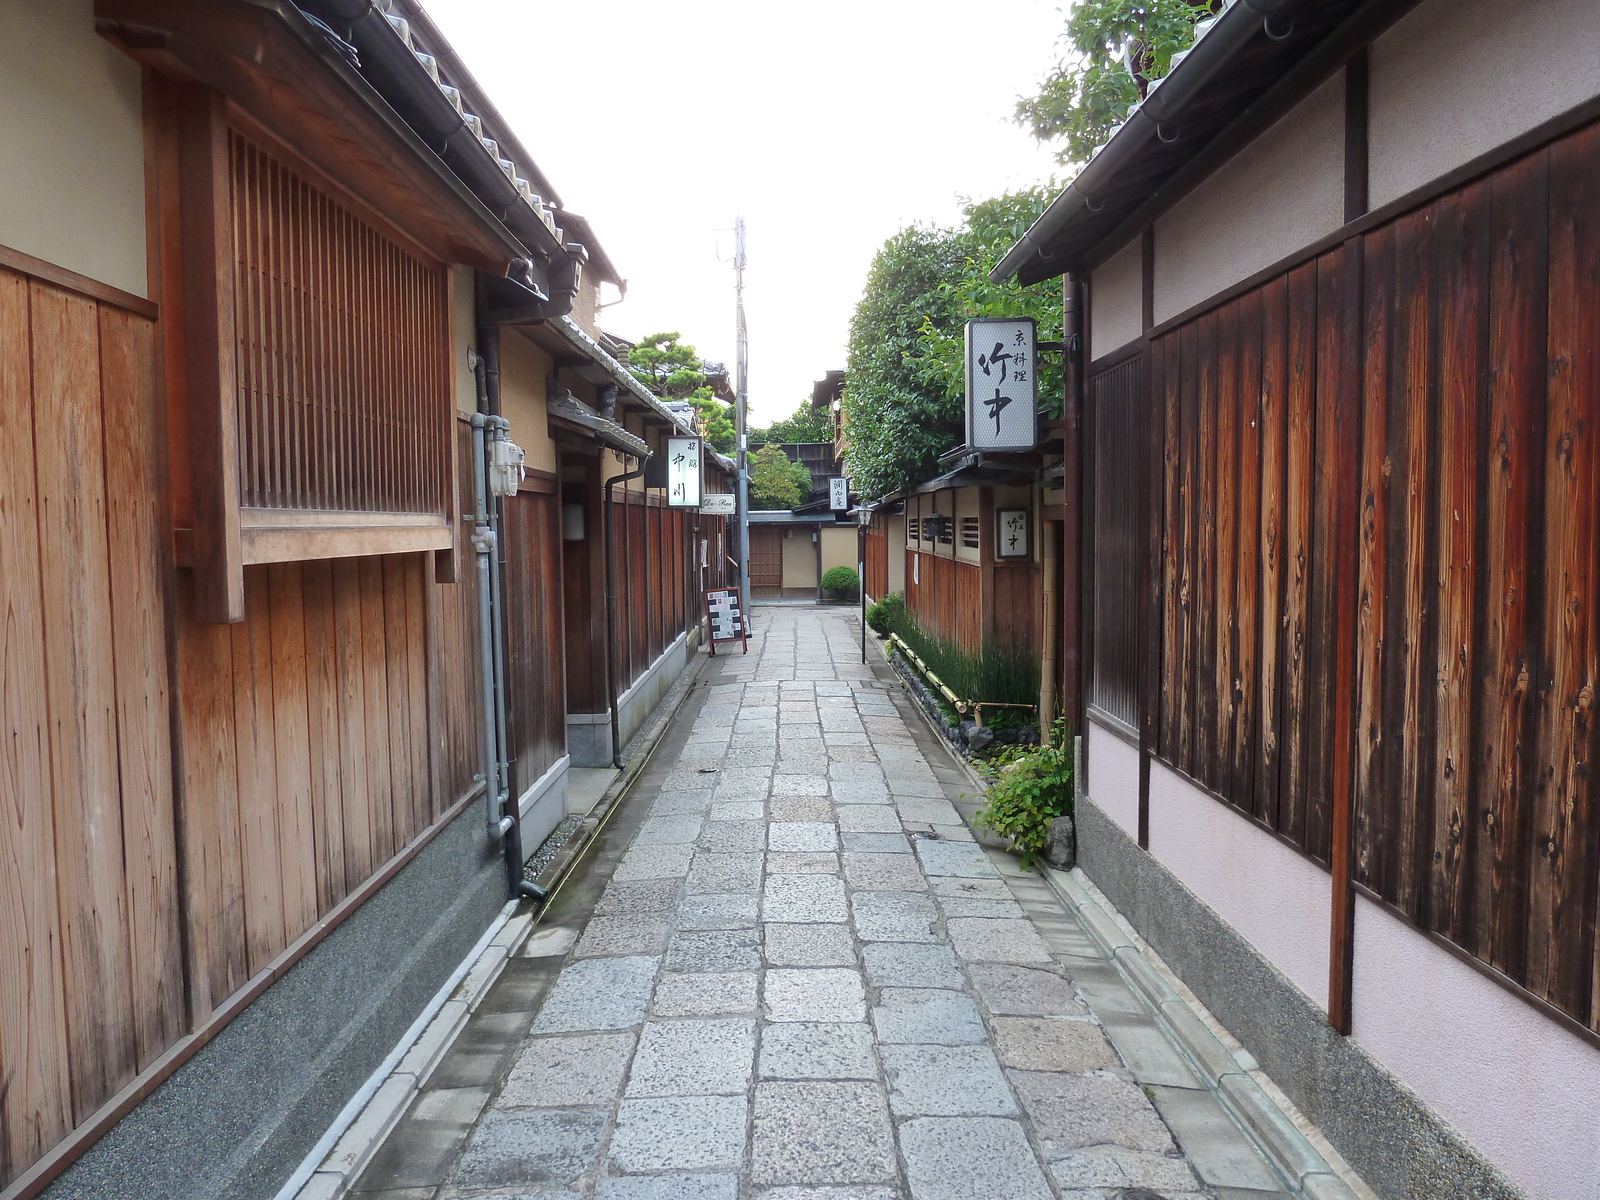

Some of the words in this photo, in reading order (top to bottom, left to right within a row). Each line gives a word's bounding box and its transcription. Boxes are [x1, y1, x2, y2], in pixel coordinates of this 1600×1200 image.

[1013, 330, 1027, 382] 京料理
[979, 342, 1014, 437] 竹中
[672, 452, 686, 503] 中川
[1007, 517, 1019, 551] 竹中
